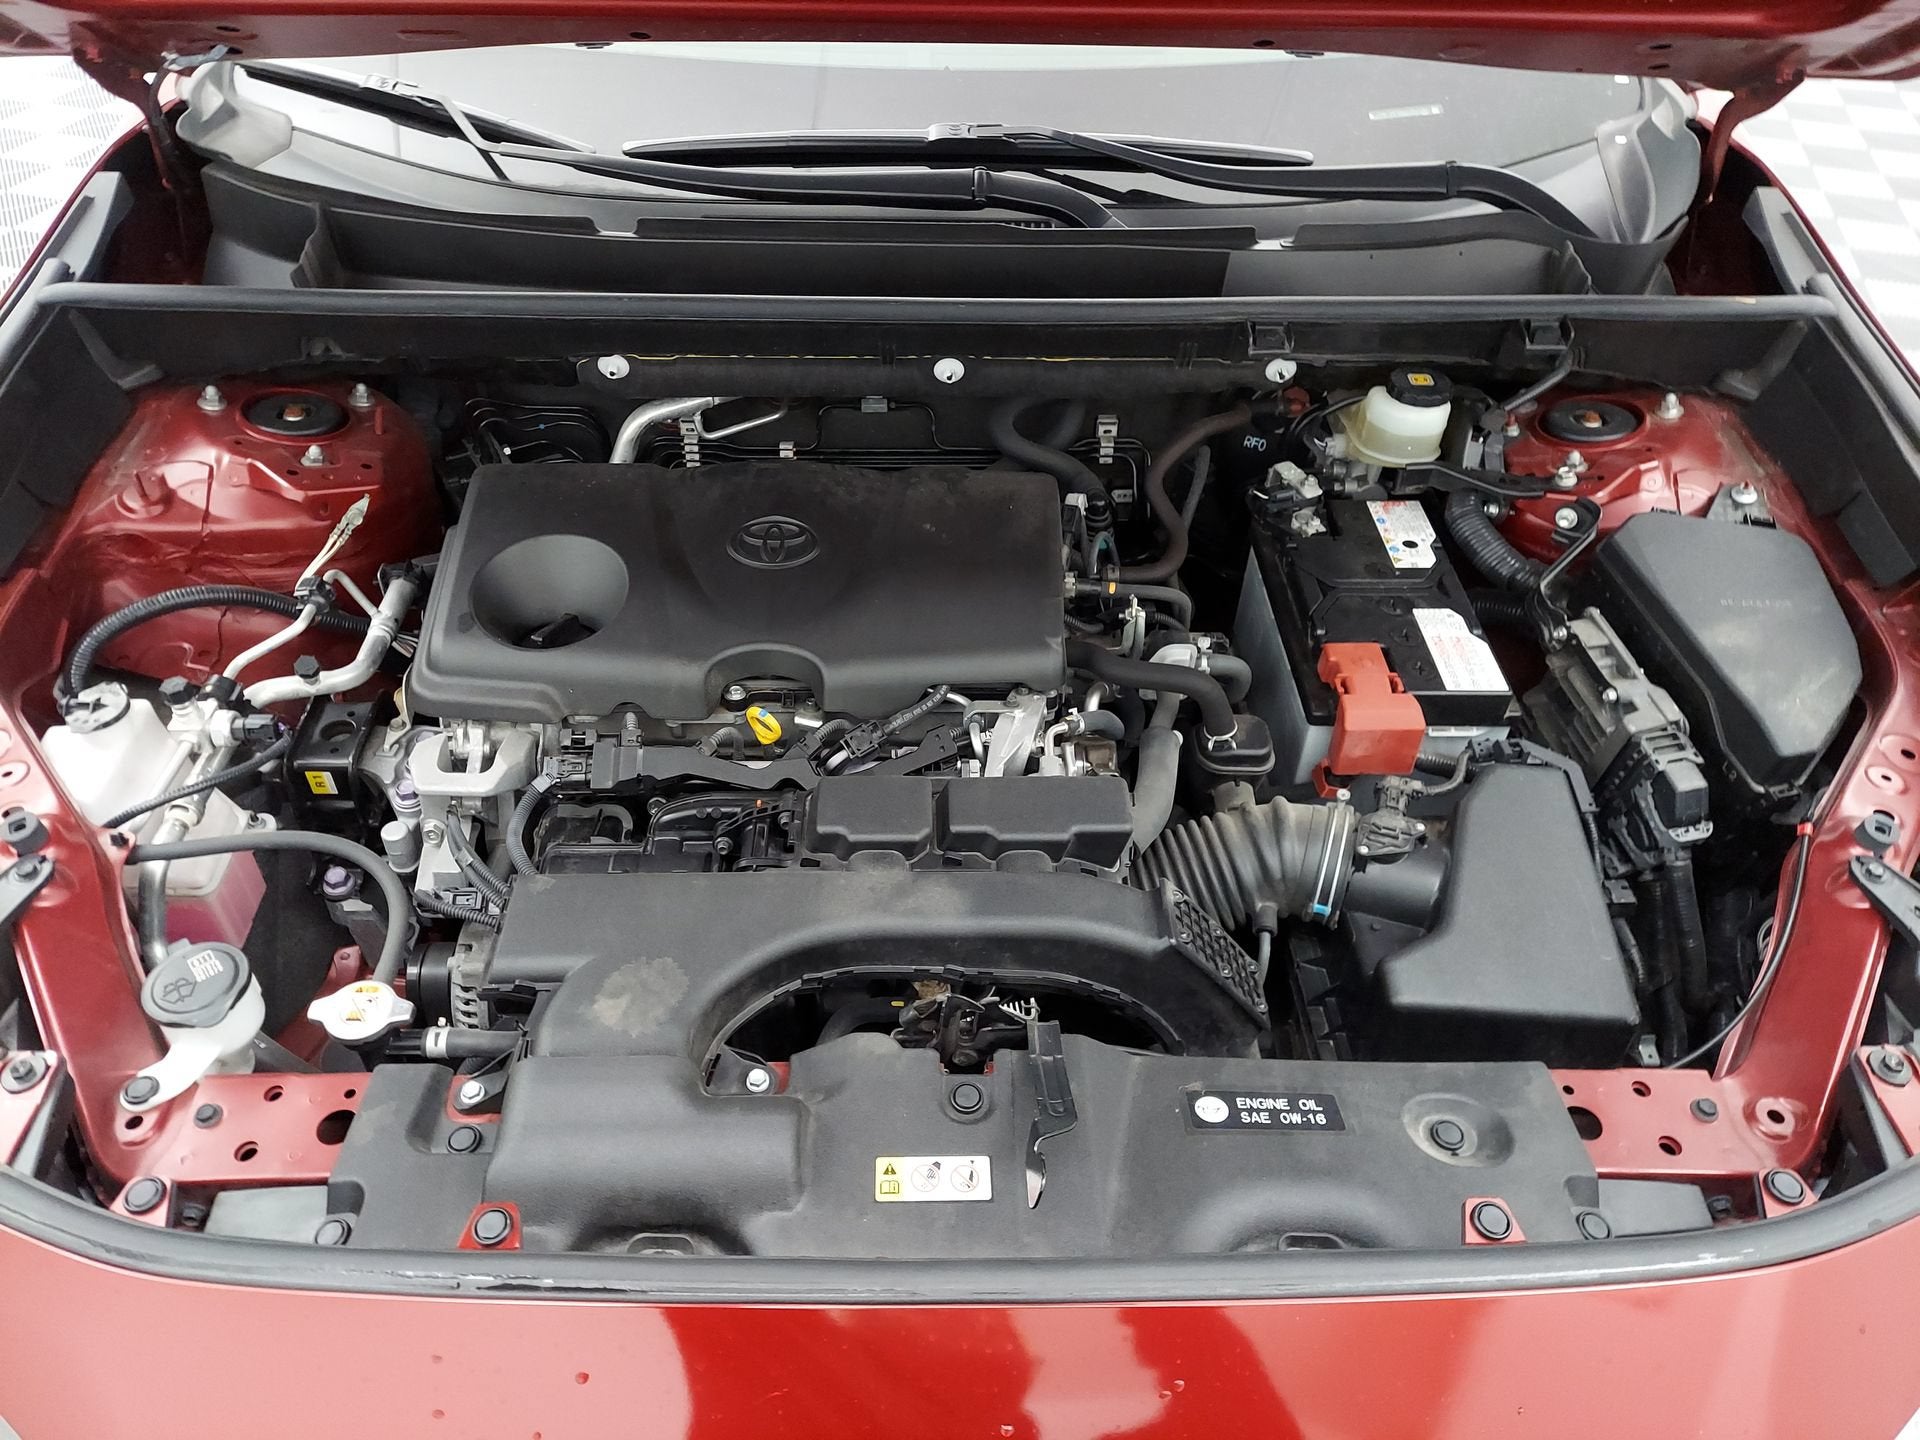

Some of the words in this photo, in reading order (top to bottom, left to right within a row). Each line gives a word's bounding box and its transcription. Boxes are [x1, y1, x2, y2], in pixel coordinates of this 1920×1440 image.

[1235, 1097, 1291, 1110] ENGINE
[1298, 1099, 1323, 1111] OIL
[1240, 1112, 1272, 1124] SAE
[1279, 1113, 1327, 1125] 0W-16
